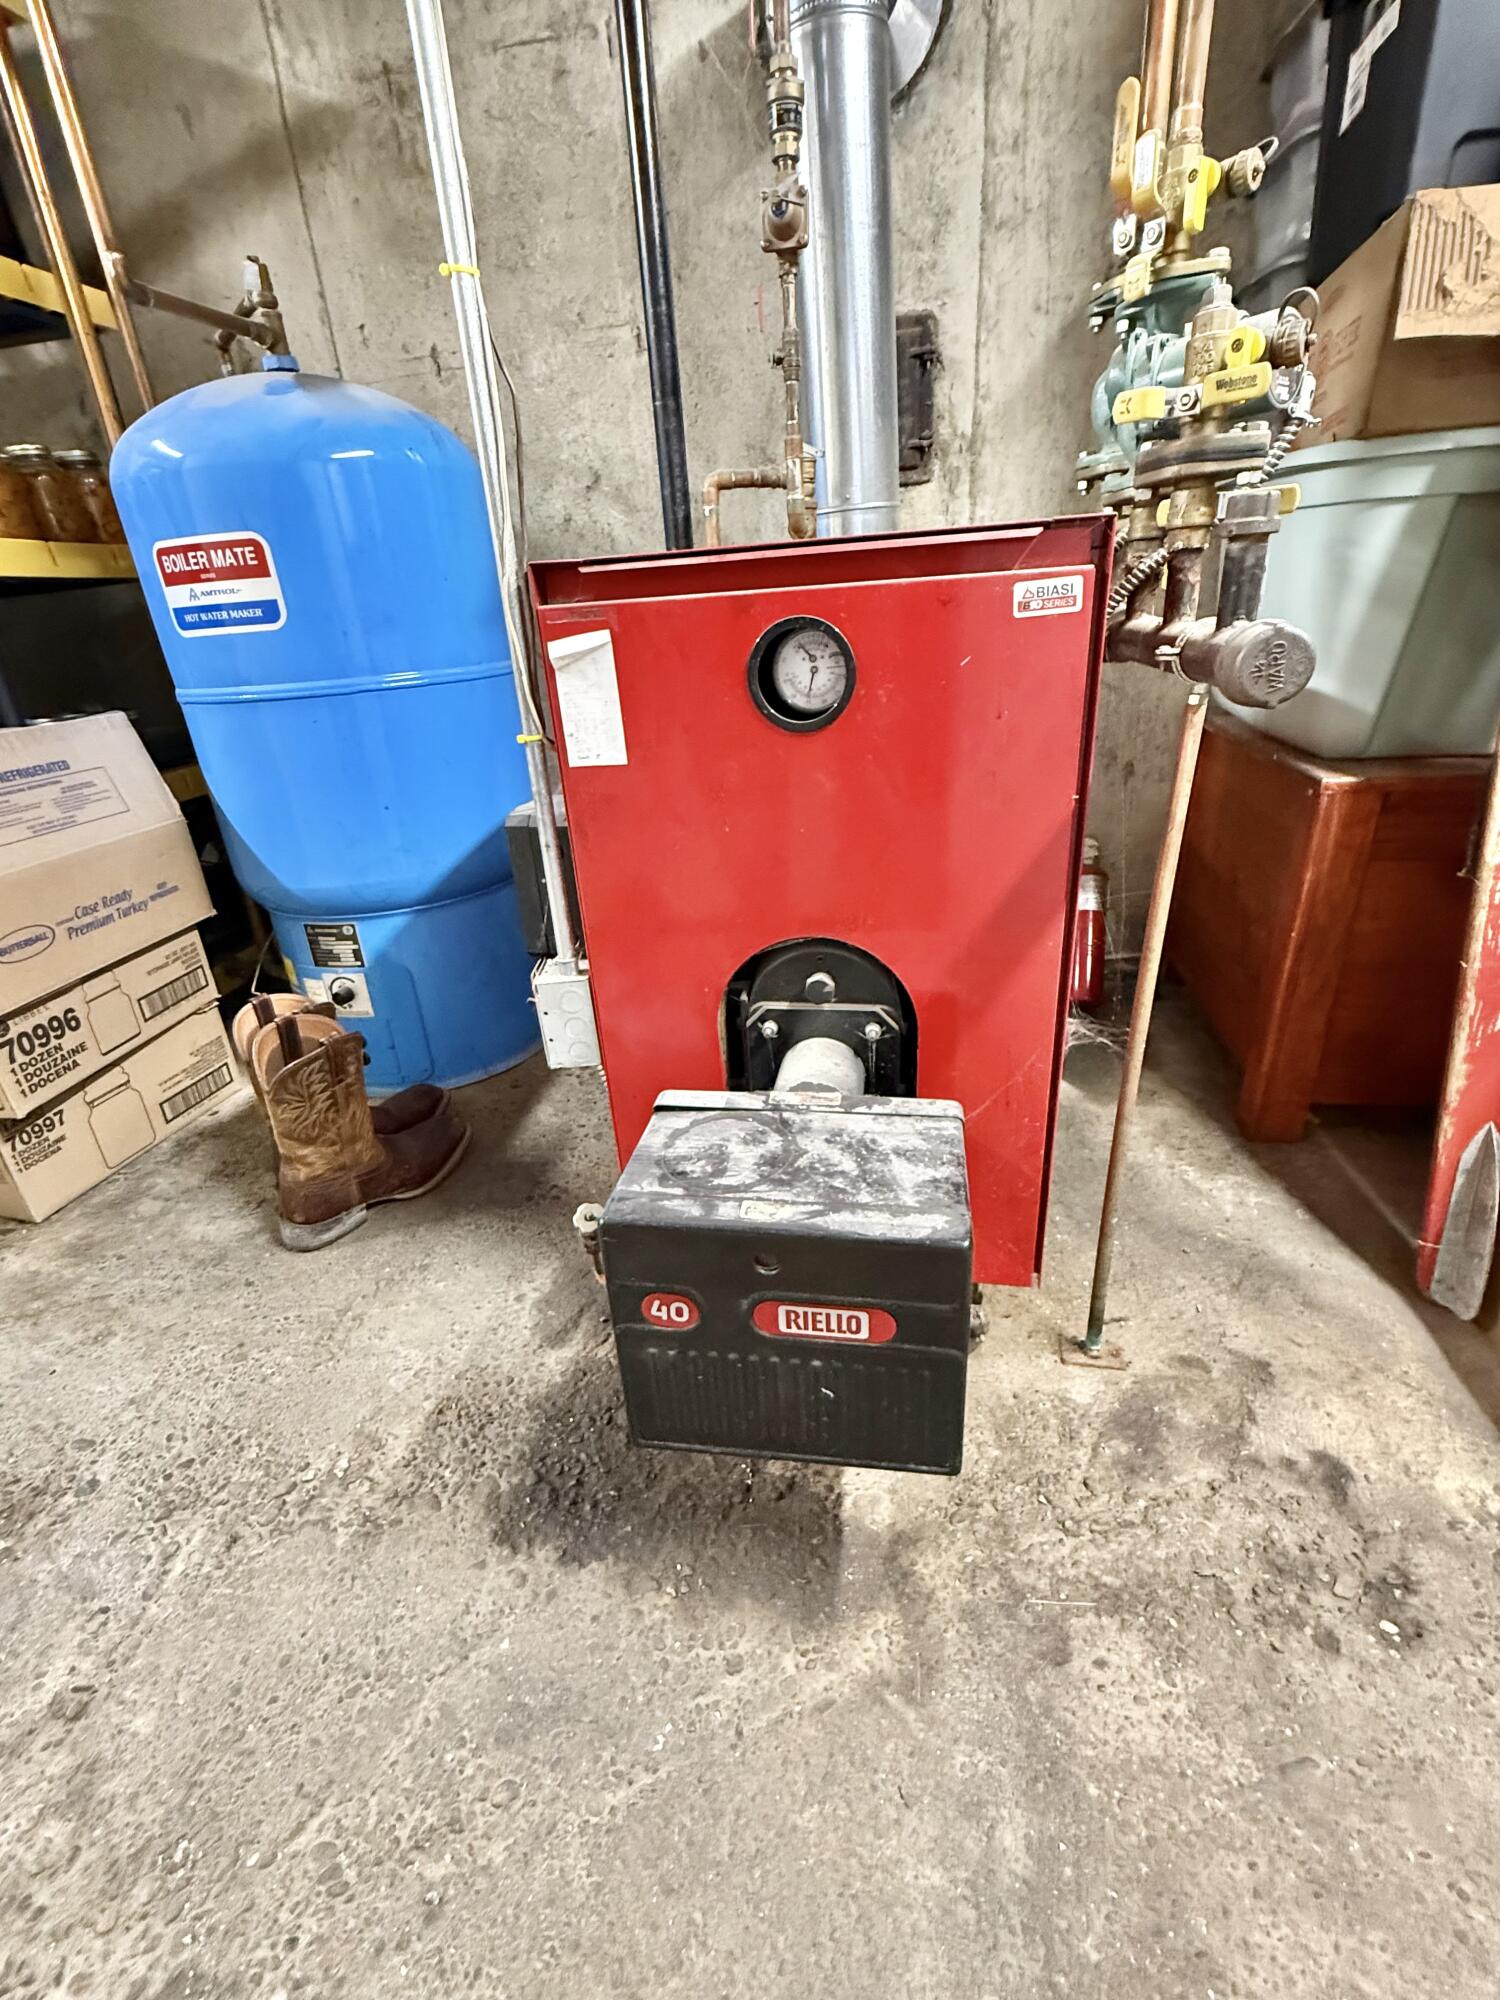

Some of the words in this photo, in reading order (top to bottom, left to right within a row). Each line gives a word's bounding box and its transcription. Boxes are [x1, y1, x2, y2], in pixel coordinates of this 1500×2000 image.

[161, 550, 210, 574] BOILER
[209, 546, 259, 569] MATE
[1036, 582, 1074, 598] BIASI
[1043, 597, 1074, 609] SERIES
[184, 613, 199, 623] HOT
[200, 610, 229, 622] WATER
[229, 608, 263, 620] MAKER
[1265, 640, 1288, 695] WARD
[67, 911, 116, 940] Premium
[116, 899, 149, 920] Turkey
[74, 901, 100, 920] Case
[102, 889, 133, 909] Ready
[0, 1007, 81, 1065] 70996
[10, 1067, 18, 1077] 1
[18, 1042, 64, 1073] DOZEN
[15, 1078, 23, 1088] 1
[23, 1041, 89, 1083] DOUZAINE
[20, 1088, 28, 1098] 1
[28, 1059, 81, 1095] DOCENA
[4, 1108, 65, 1153] 70997
[17, 1136, 50, 1158] DOZEN
[650, 1299, 690, 1323] 40
[784, 1309, 863, 1336] RIELLO
